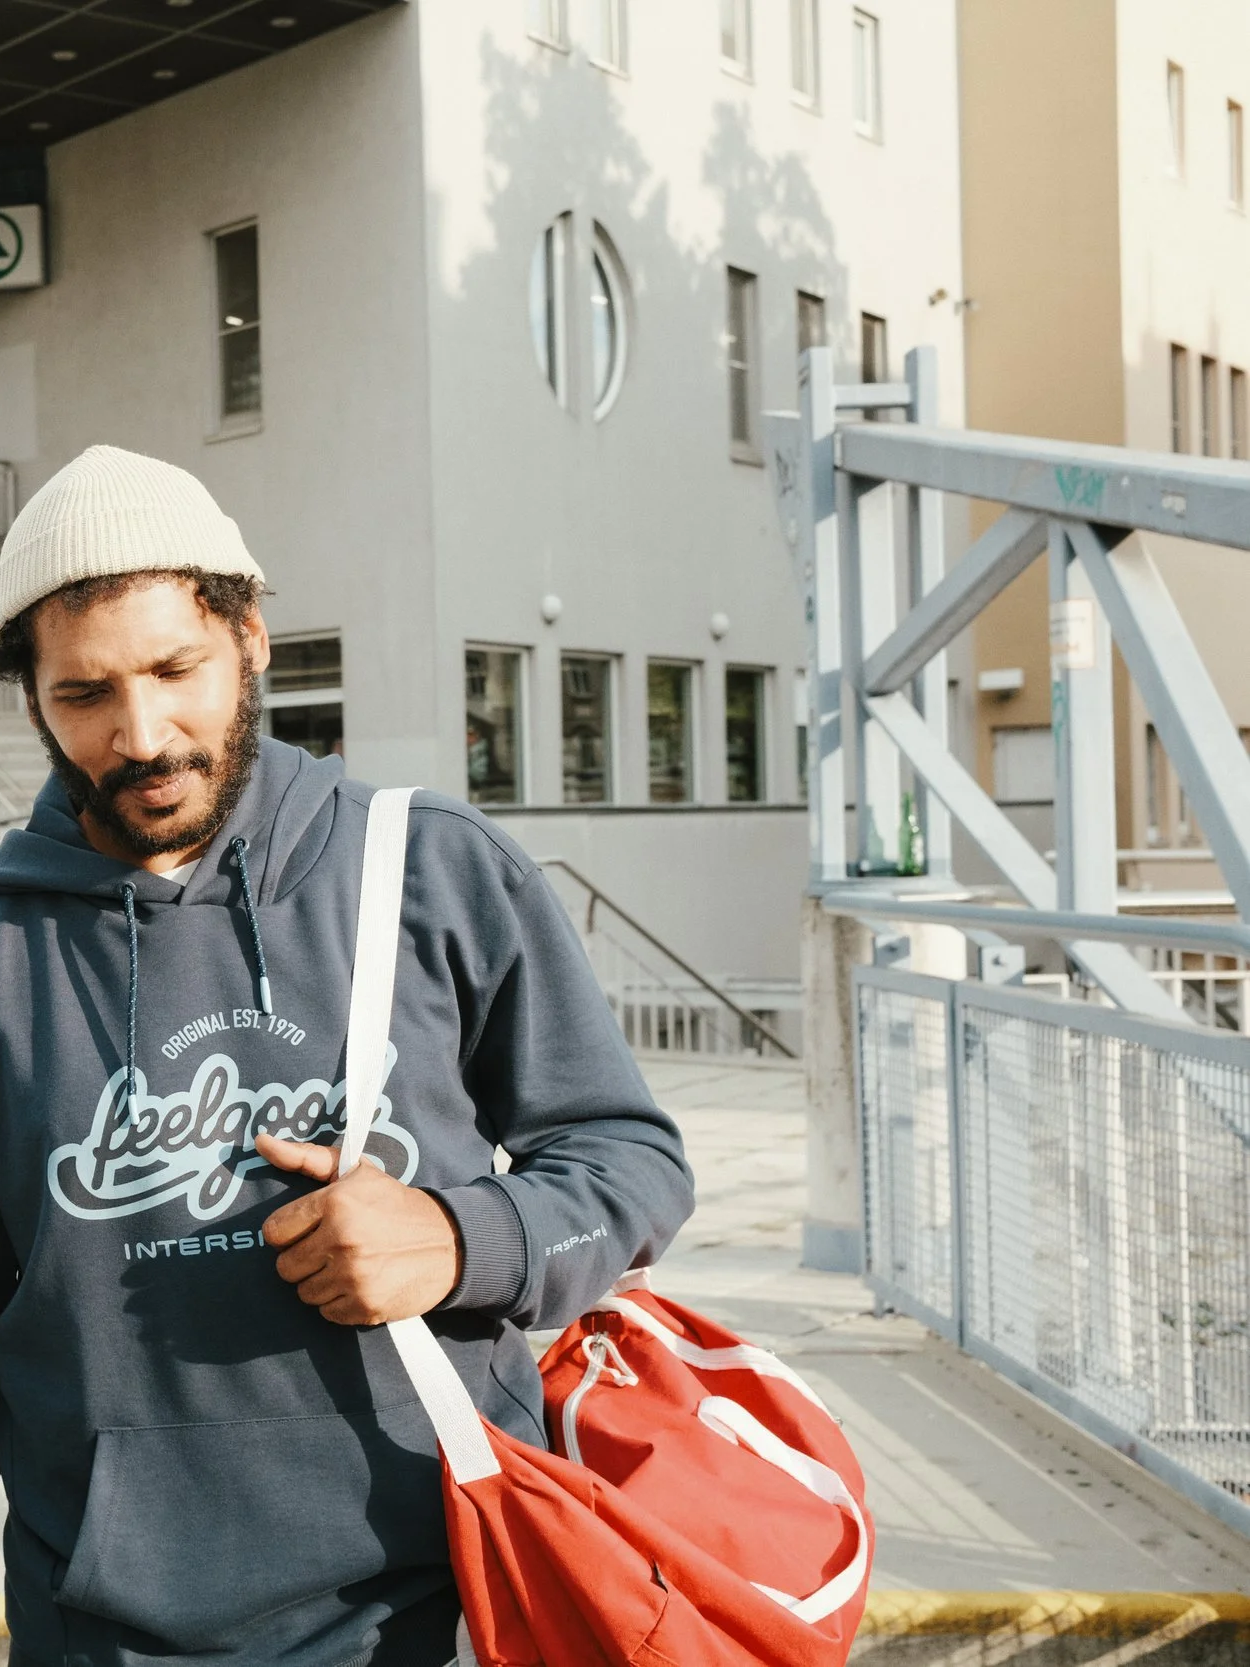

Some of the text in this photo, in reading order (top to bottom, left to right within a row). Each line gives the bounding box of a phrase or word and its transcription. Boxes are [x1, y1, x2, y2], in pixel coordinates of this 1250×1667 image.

[161, 1008, 306, 1060] ORIGINAL EST. 1970
[123, 1229, 266, 1260] INTERS
